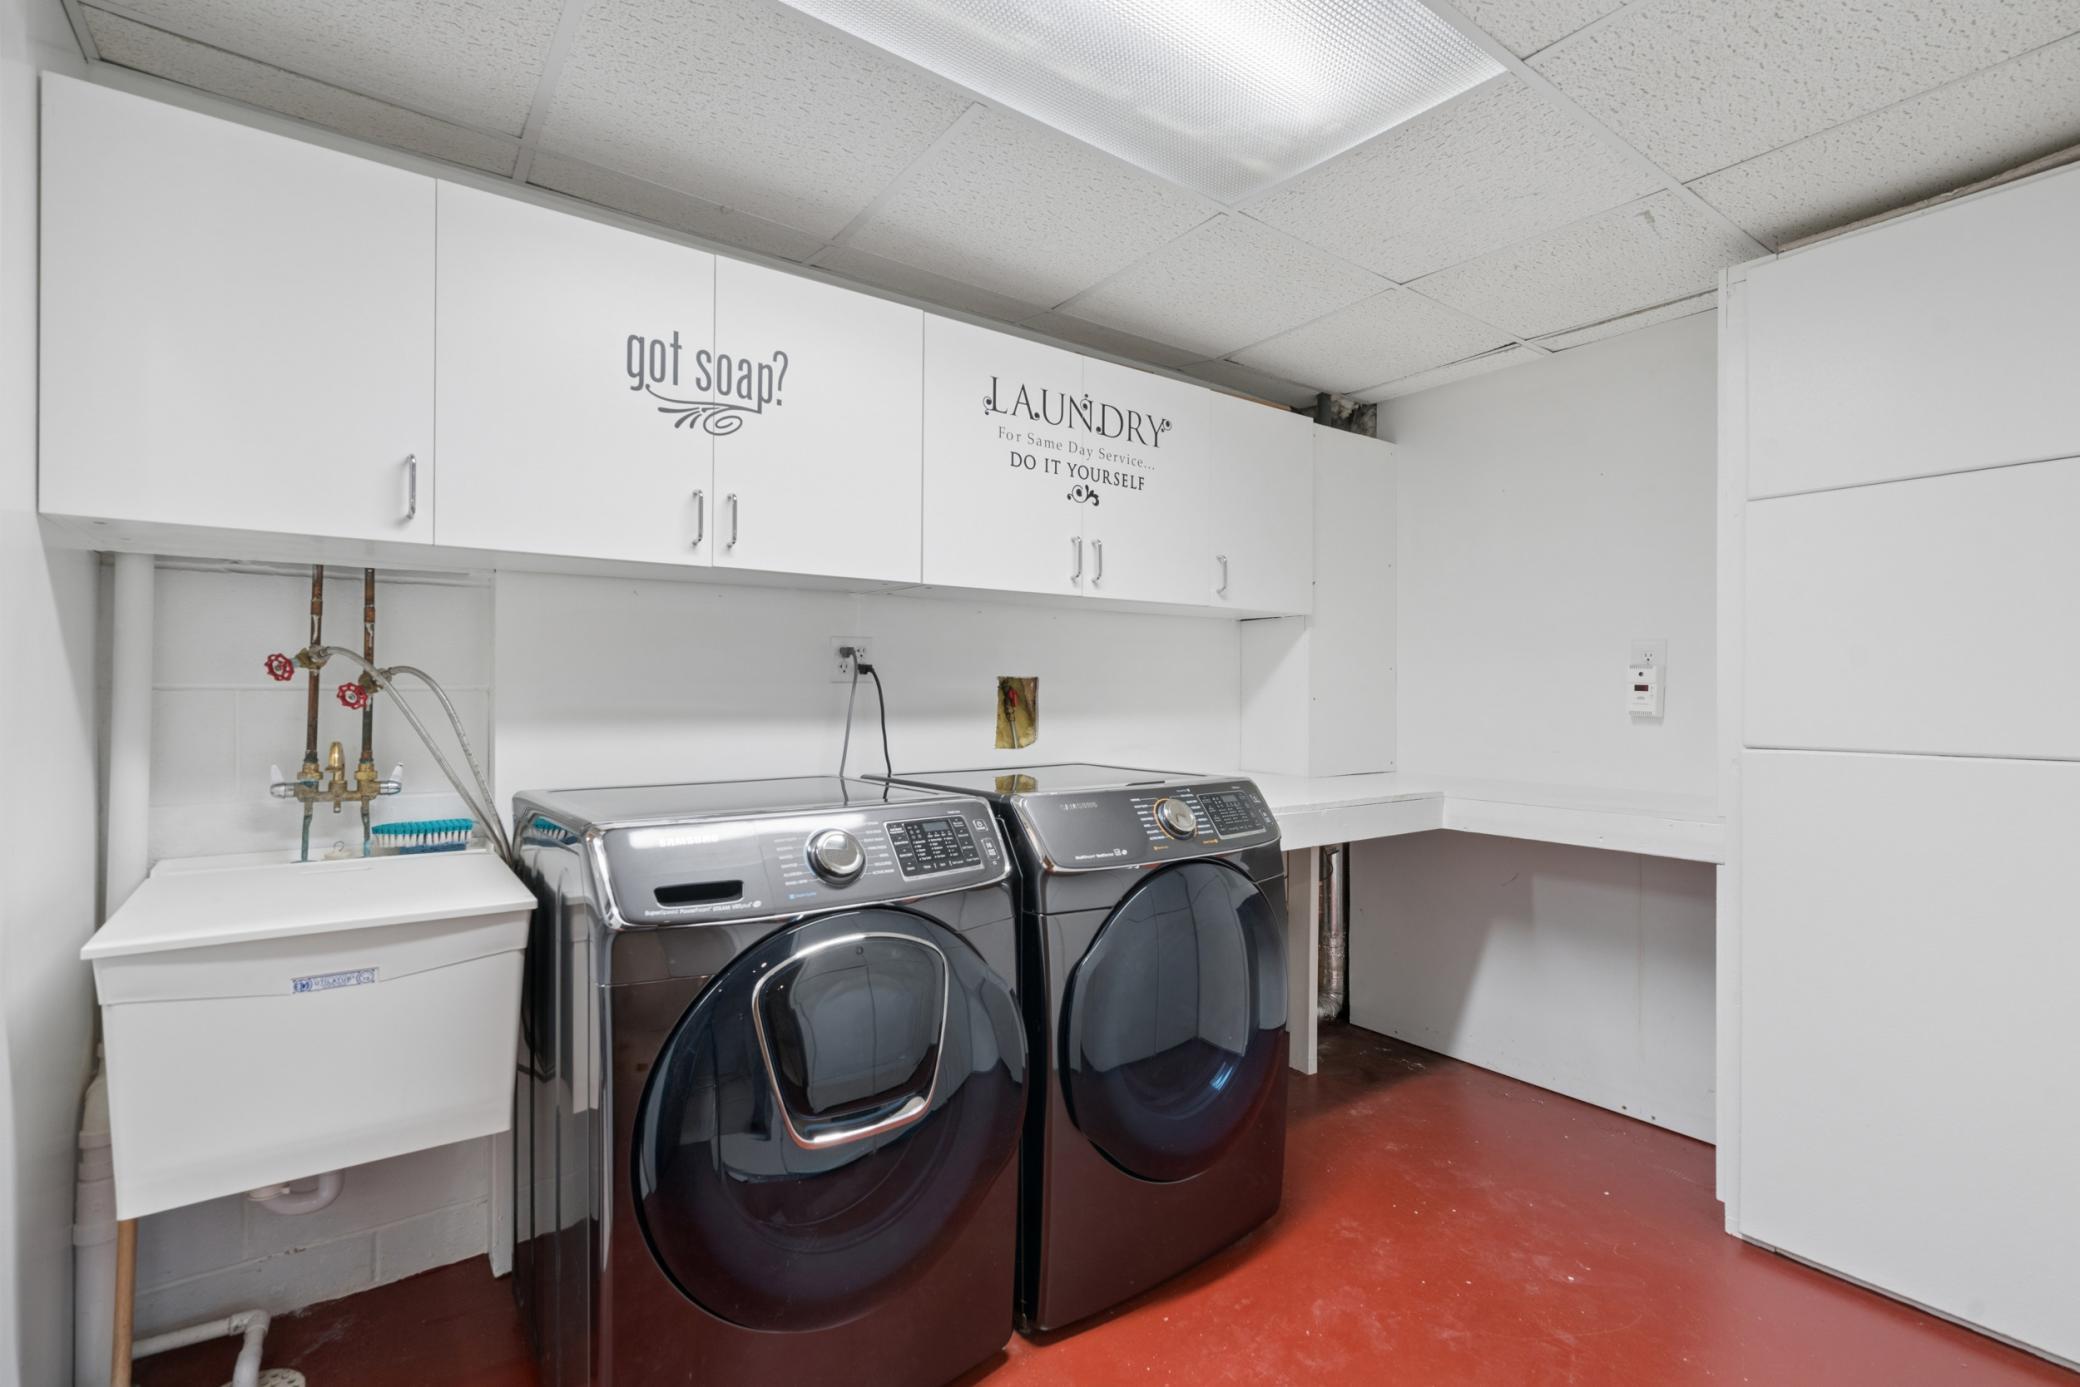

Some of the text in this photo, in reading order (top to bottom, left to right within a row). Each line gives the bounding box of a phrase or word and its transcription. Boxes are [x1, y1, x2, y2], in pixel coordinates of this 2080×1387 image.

[626, 330, 789, 414] got soap?
[984, 376, 1171, 448] LAUNDRY
[998, 426, 1022, 442] For
[1027, 432, 1063, 451] Same
[1068, 441, 1094, 460] Day
[1010, 451, 1145, 491] DO IT YOURSELF
